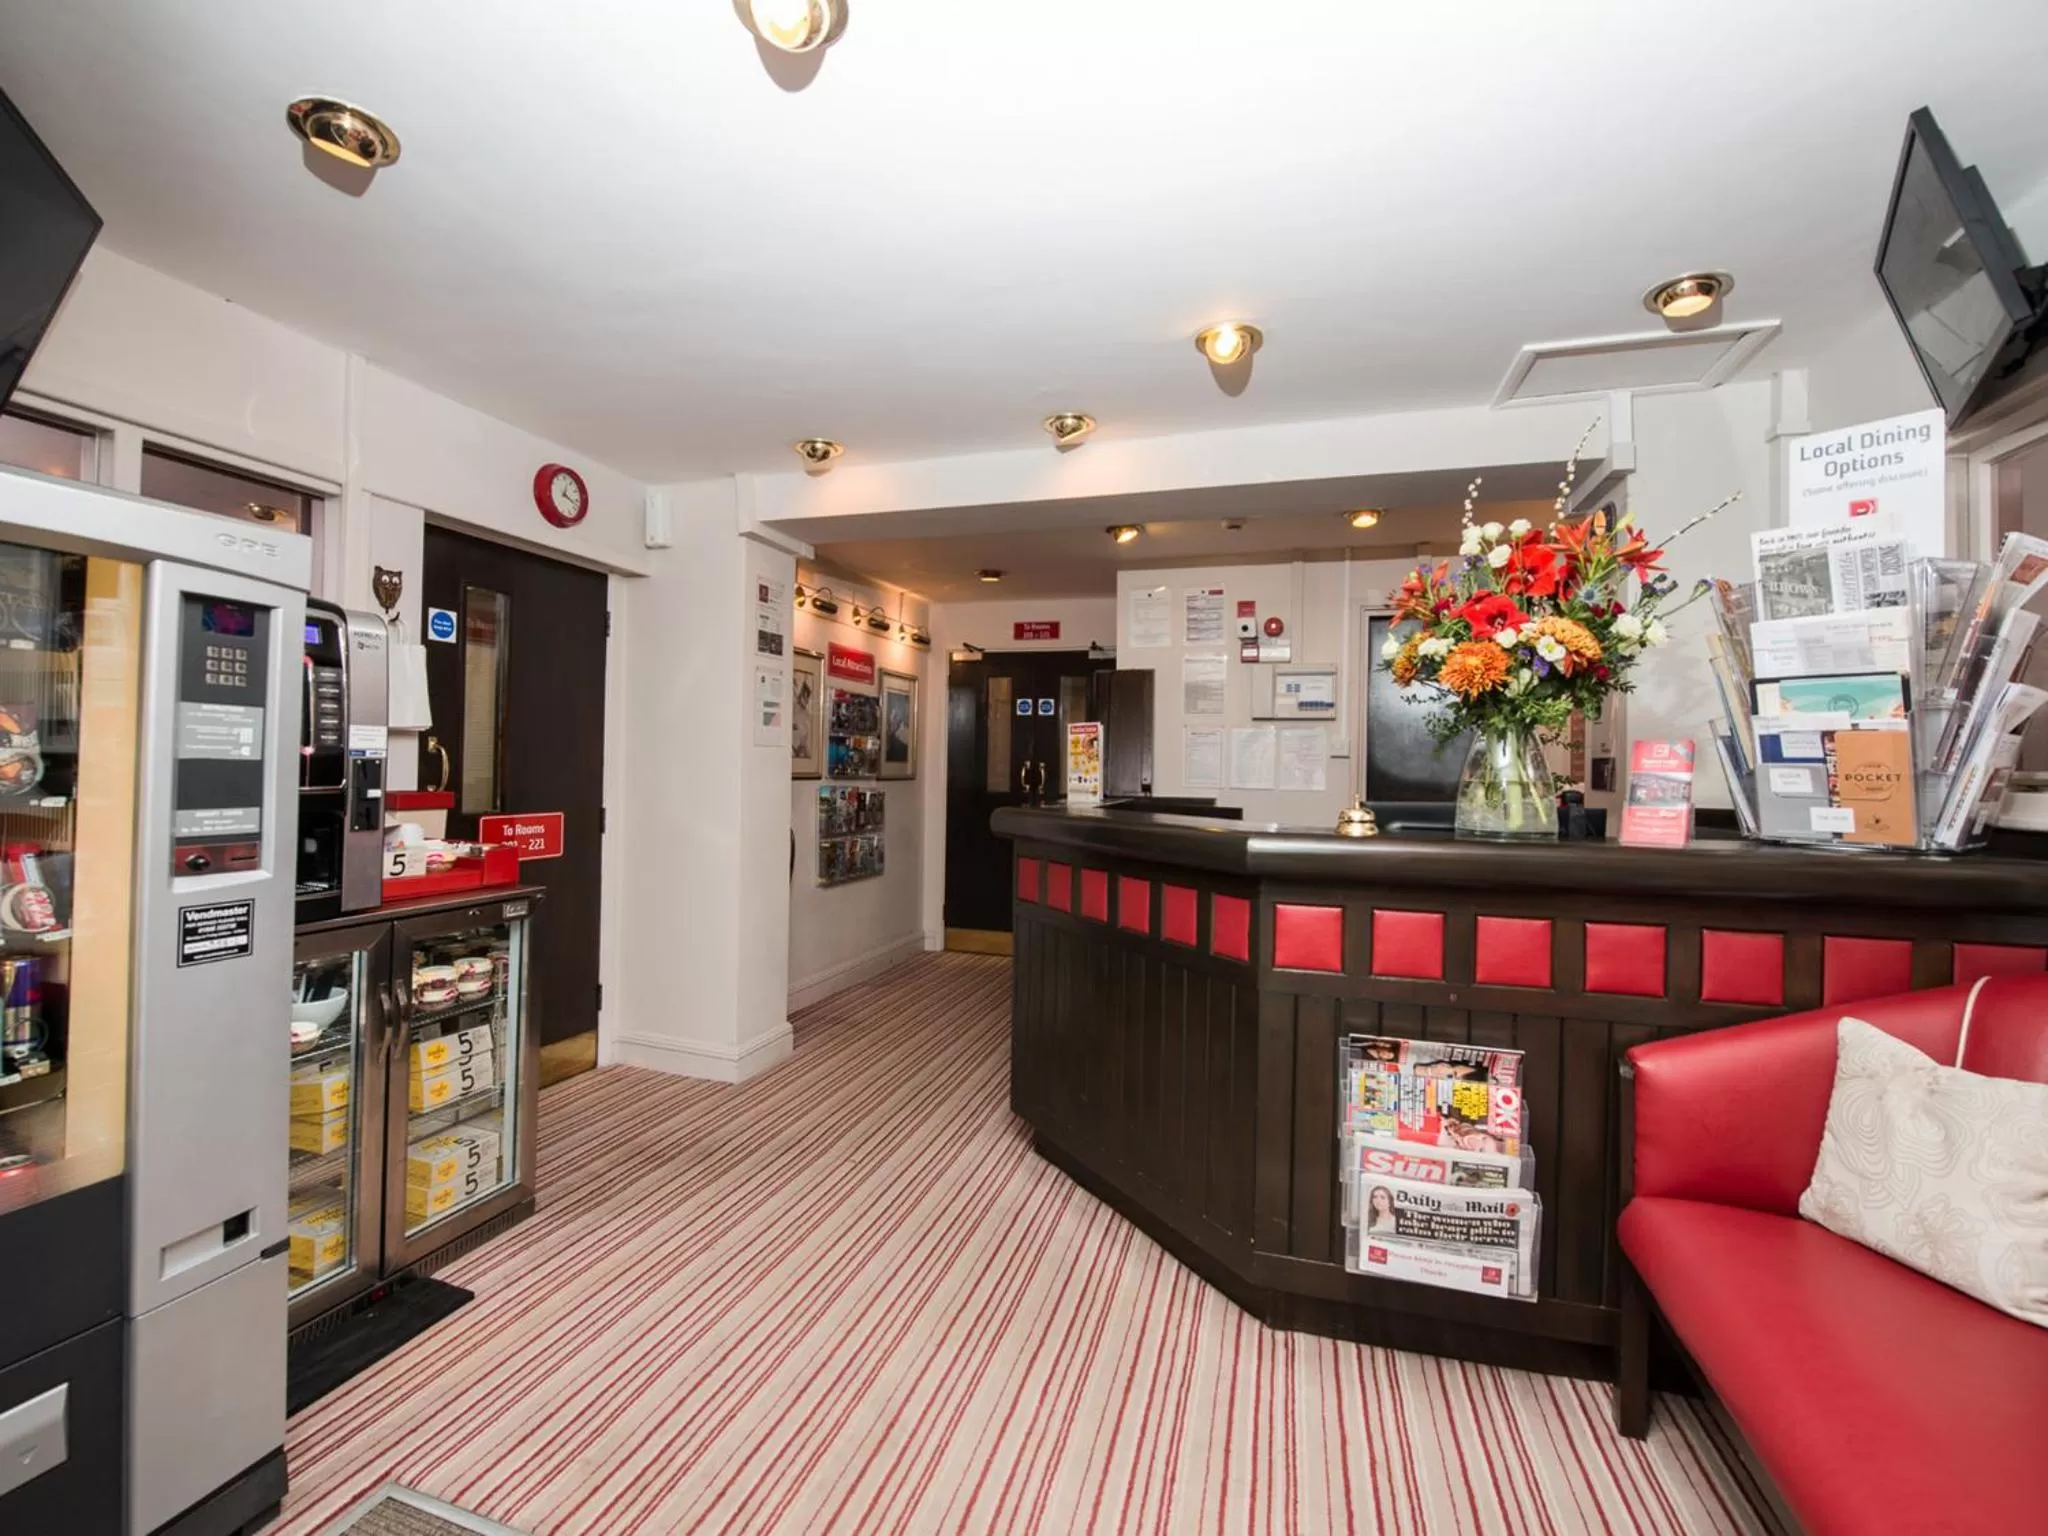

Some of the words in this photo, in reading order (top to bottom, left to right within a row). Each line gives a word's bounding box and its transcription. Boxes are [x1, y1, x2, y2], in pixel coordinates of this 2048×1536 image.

[1800, 435, 1853, 462] Local
[1861, 424, 1932, 449] Dining
[1824, 451, 1905, 479] Options
[1844, 773, 1901, 782] POCKET
[502, 824, 514, 836] To
[515, 823, 545, 836] Rooms
[389, 853, 408, 877] 5
[185, 906, 249, 922] Vendmaster
[457, 1031, 473, 1055] 5
[460, 1067, 475, 1092] 5
[1495, 1089, 1521, 1134] OK!
[467, 1143, 481, 1169] 5
[1364, 1150, 1443, 1181] Sun
[464, 1170, 479, 1196] 5
[1396, 1190, 1442, 1212] Daily
[1465, 1200, 1504, 1214] Mail
[1399, 1217, 1430, 1229] take
[1470, 1224, 1500, 1238] pills
[1501, 1227, 1515, 1237] to
[1432, 1213, 1482, 1226] women
[1483, 1219, 1510, 1229] who
[1399, 1226, 1432, 1238] calm
[1470, 1233, 1516, 1246] nerves
